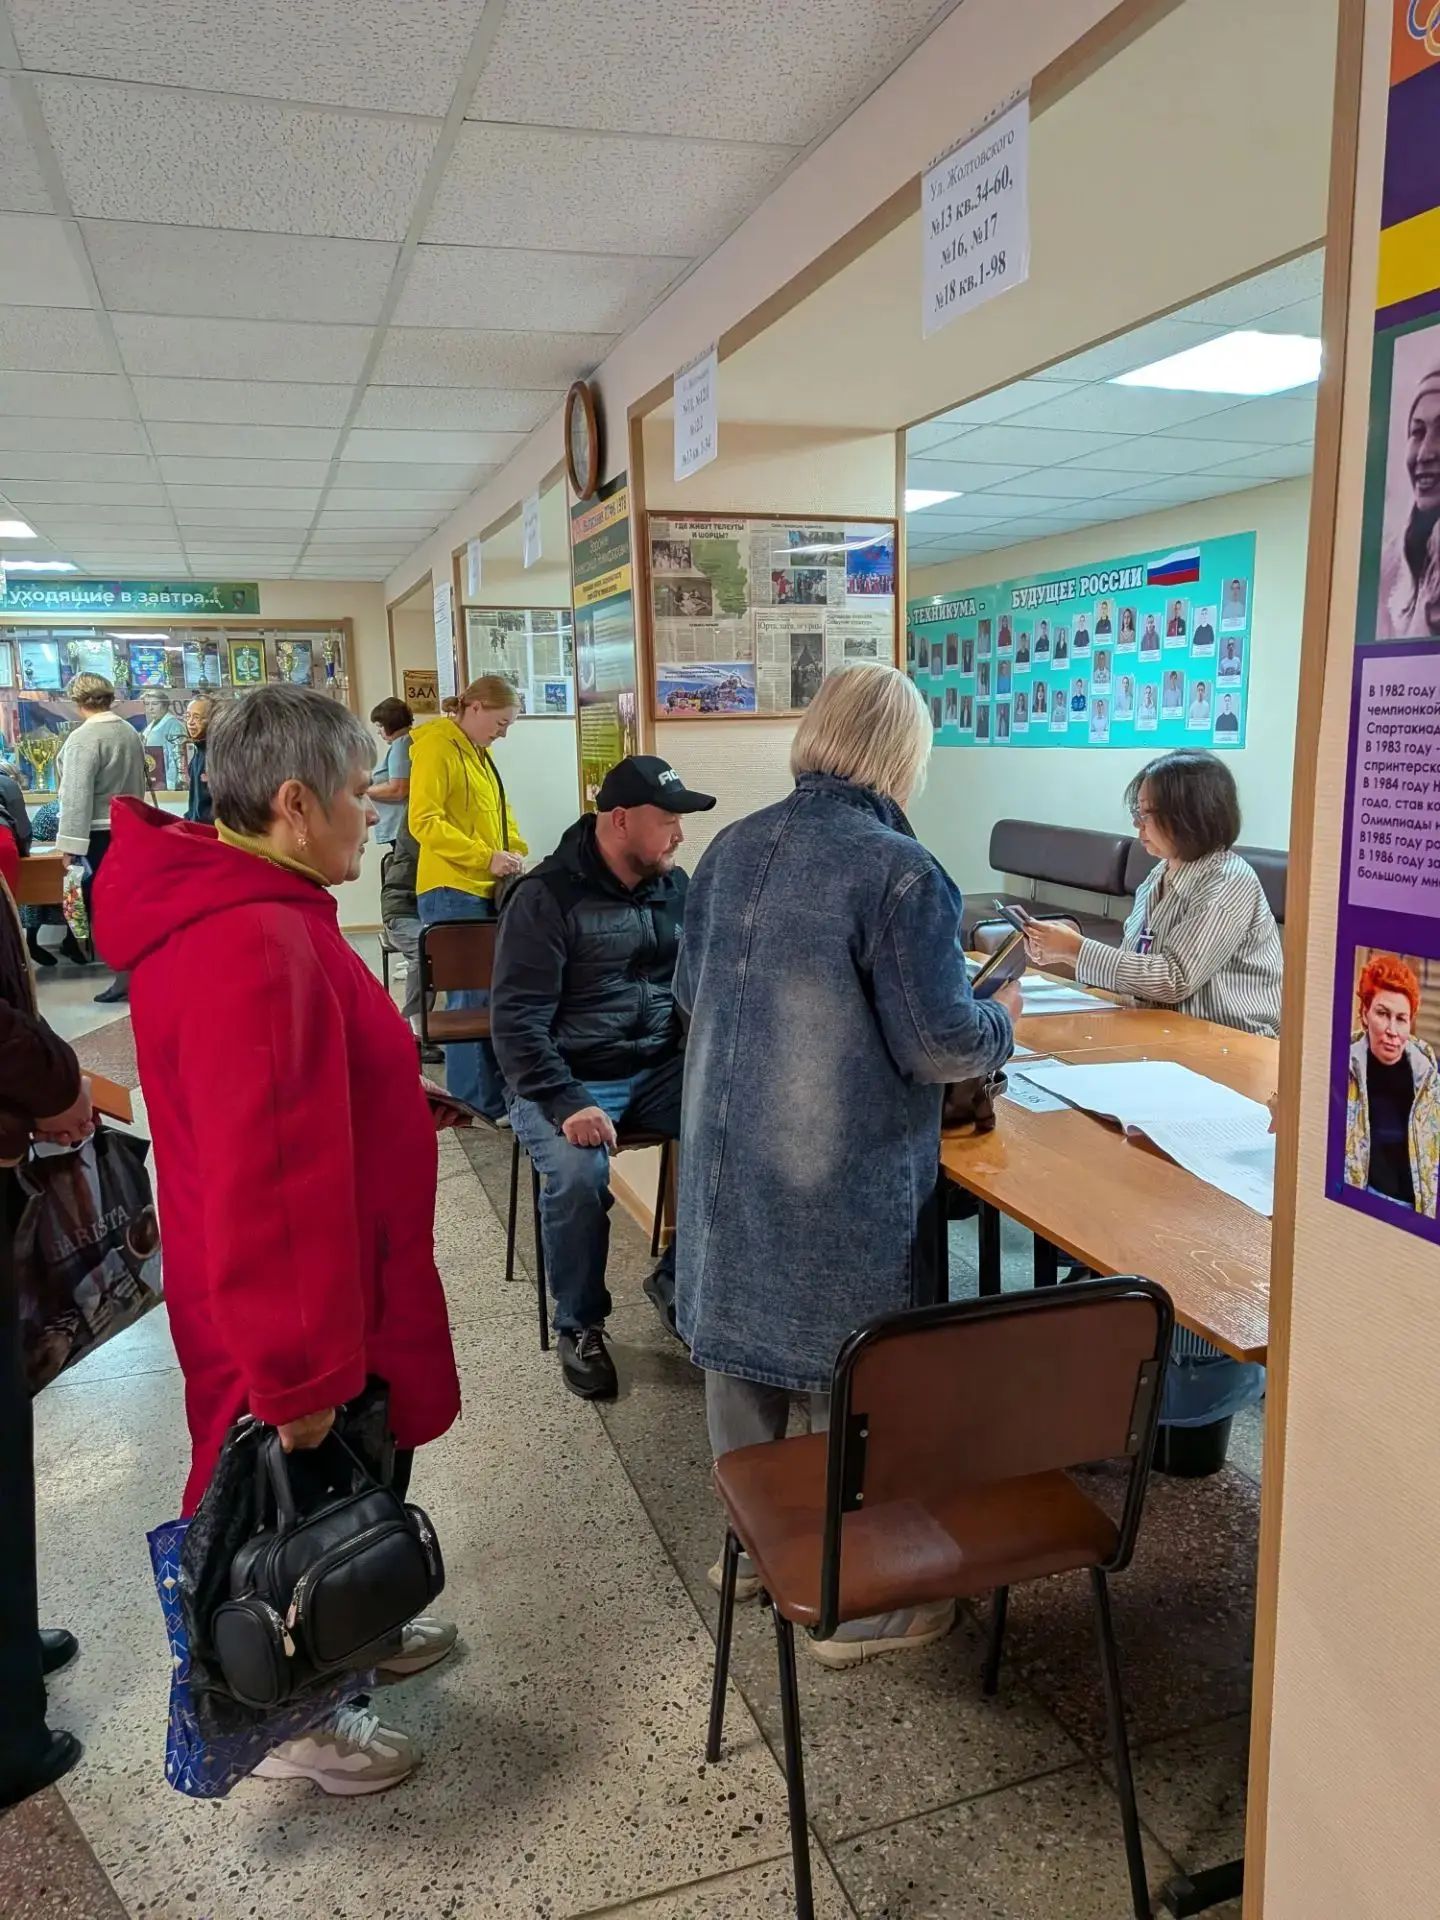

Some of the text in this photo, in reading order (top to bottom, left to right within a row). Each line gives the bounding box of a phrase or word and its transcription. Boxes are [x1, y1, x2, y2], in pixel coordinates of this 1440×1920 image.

[930, 129, 1015, 202] Ул. Жолтовского
[930, 203, 952, 239] №13
[941, 211, 998, 271] №16, №17
[935, 250, 1006, 312] №18 кв.1-98
[674, 522, 688, 530] ГДЕ
[9, 590, 219, 607] уходящие в завтра...
[913, 598, 977, 625] ТЕХНИКУМА
[1011, 579, 1077, 609] БУДУЩЕЕ
[1079, 566, 1143, 597] РОССИИ
[408, 686, 437, 699] ЗАЛ
[1369, 684, 1436, 699] В 1982 году
[1367, 702, 1440, 716] чемпионкой
[1366, 722, 1440, 737] Спартакиад
[1366, 740, 1432, 756] В 1983 году
[1363, 777, 1369, 788] В
[1374, 777, 1399, 790] 1984
[1402, 781, 1430, 795] году
[1362, 797, 1391, 809] года,
[1395, 800, 1424, 810] став
[1361, 813, 1432, 831] Олимпиады
[1360, 831, 1392, 845] В1985
[1395, 836, 1423, 850] году
[1359, 848, 1365, 860] В
[1370, 849, 1394, 863] 1986
[1397, 855, 1424, 870] году
[1358, 866, 1418, 887] большому
